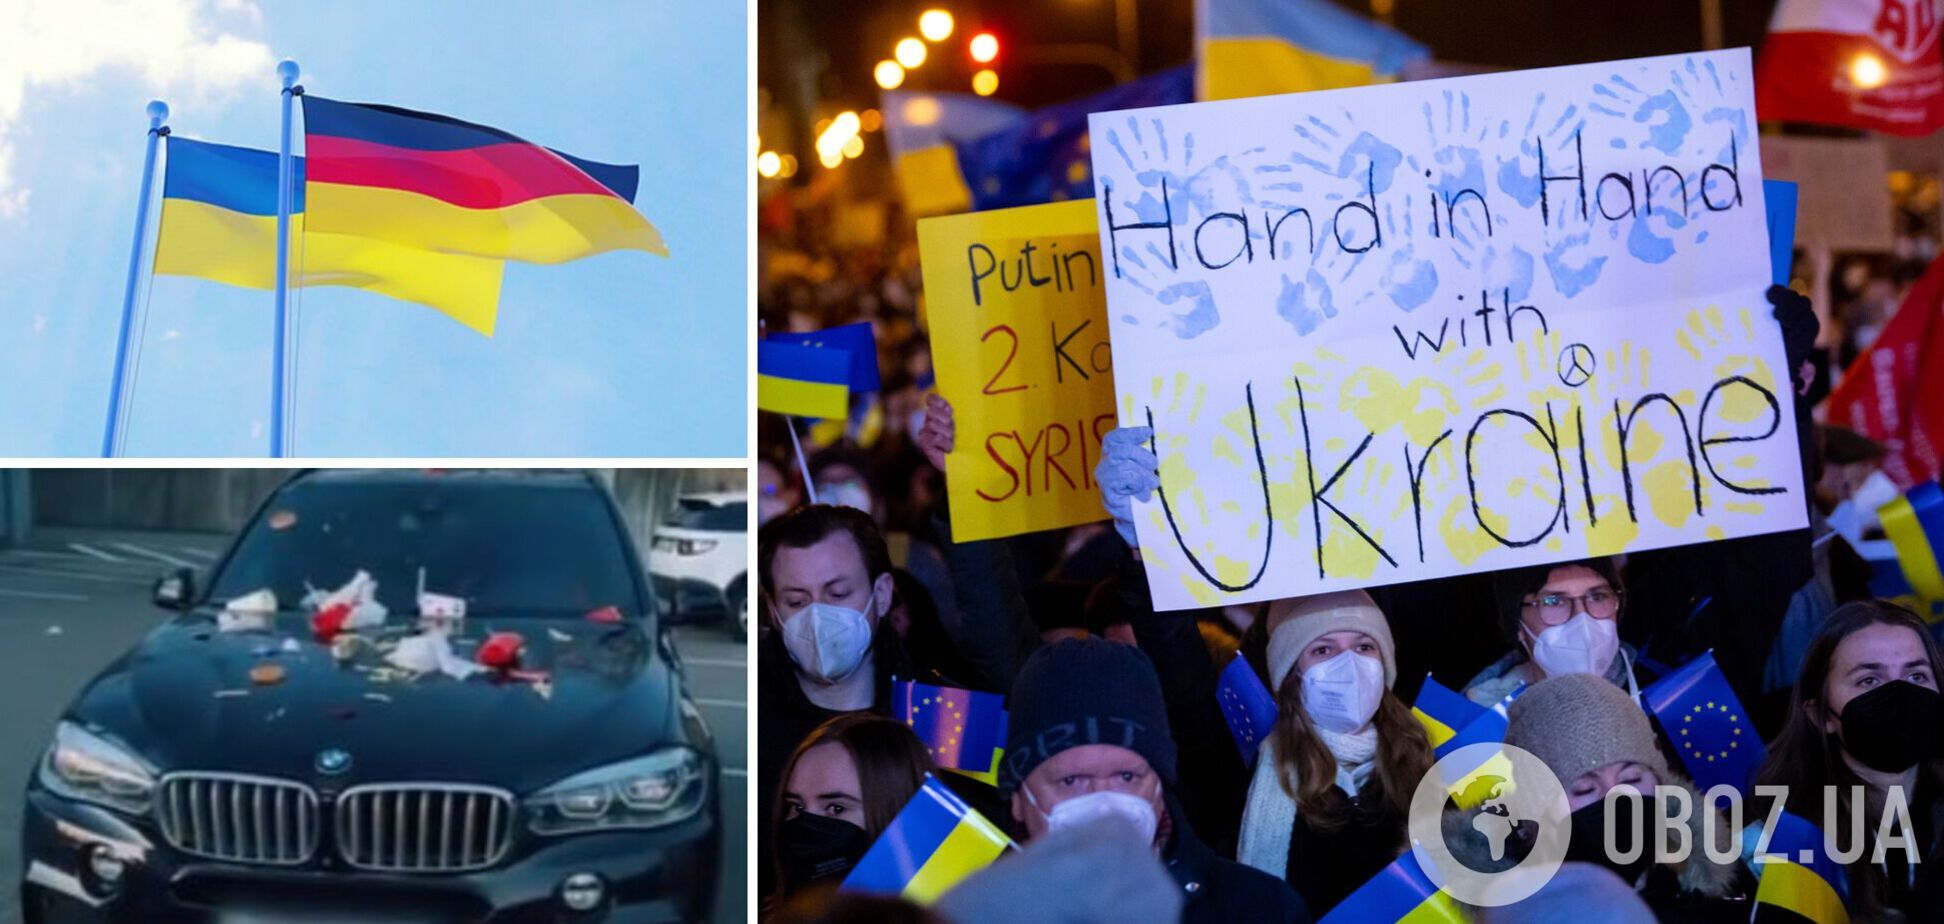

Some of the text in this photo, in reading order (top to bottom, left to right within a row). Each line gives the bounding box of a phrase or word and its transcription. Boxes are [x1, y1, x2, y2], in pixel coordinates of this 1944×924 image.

[1104, 128, 1743, 278] Hand in Hand
[967, 240, 1095, 306] Putin
[1393, 286, 1549, 360] with
[1145, 350, 1788, 593] Ukraine
